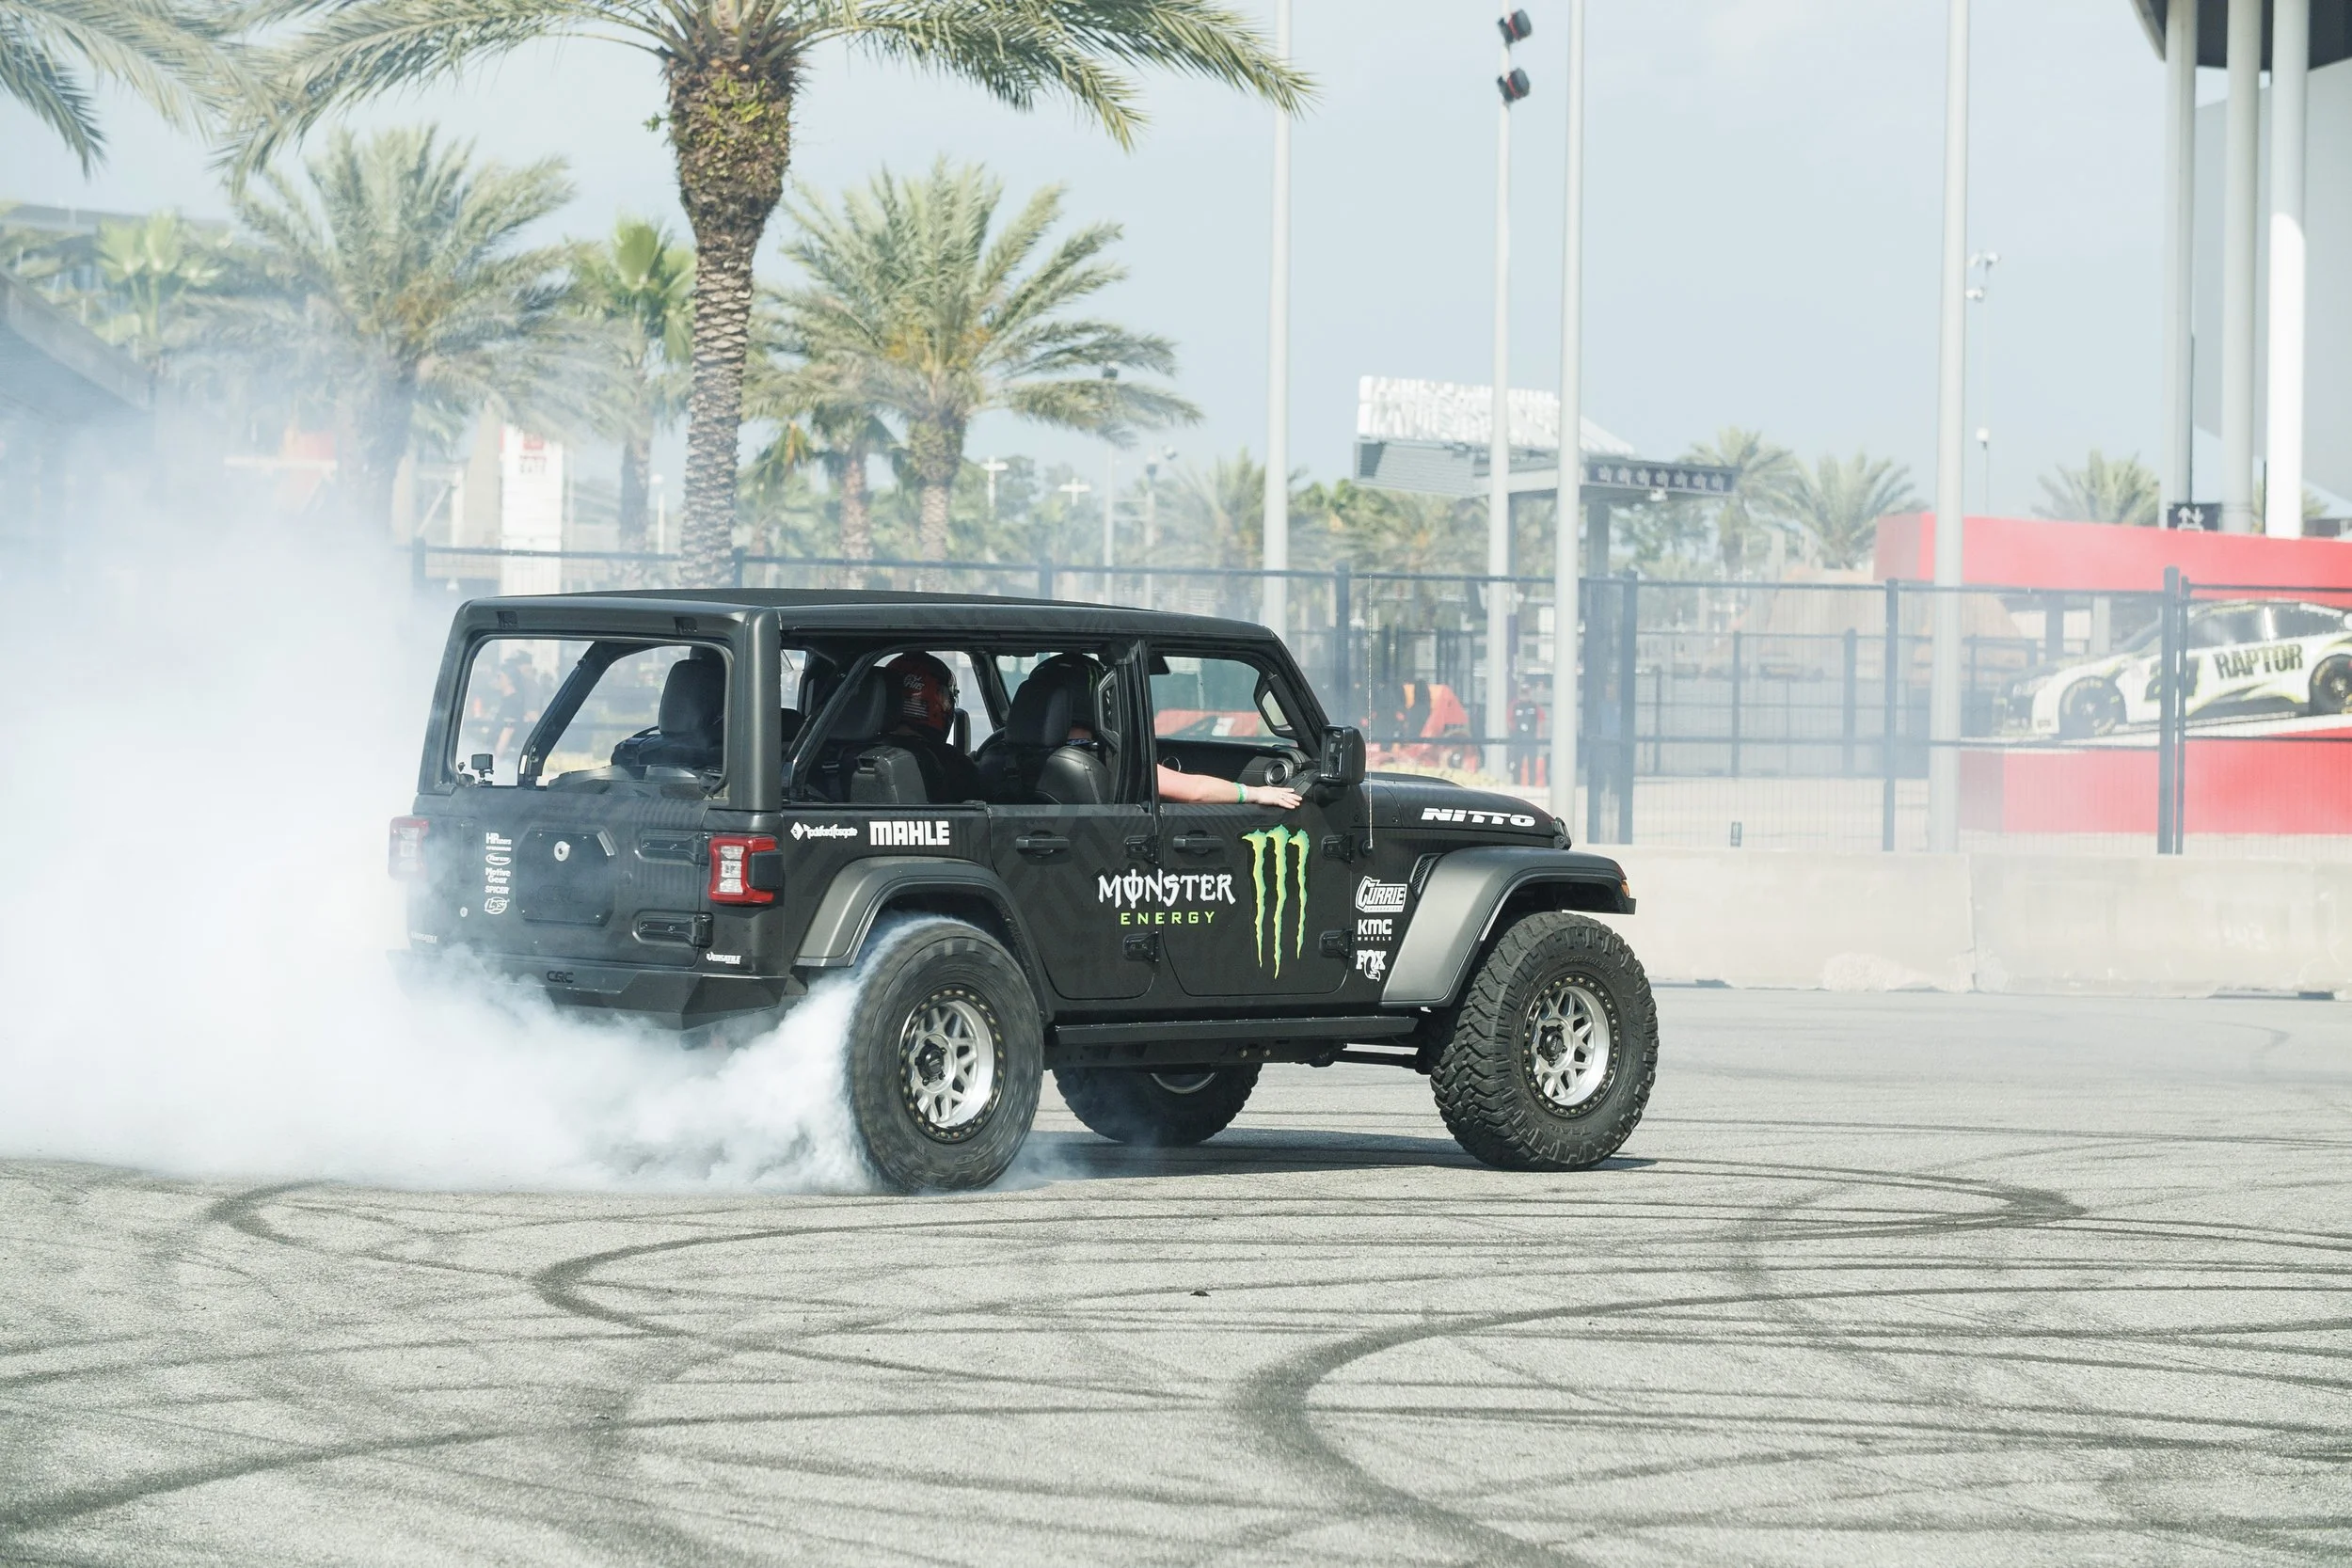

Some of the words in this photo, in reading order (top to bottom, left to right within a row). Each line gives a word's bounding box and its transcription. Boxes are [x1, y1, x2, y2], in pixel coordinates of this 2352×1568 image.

[2213, 644, 2303, 678] RAPTOR
[1421, 807, 1535, 827] NITTO
[869, 821, 949, 846] MAHLE
[485, 867, 511, 877] Motive
[485, 885, 510, 895] SPICER
[1097, 868, 1236, 909] MONSTER
[1358, 879, 1405, 908] CURRIE
[1120, 911, 1215, 925] ENERGY
[1358, 919, 1392, 935] KMC
[1356, 949, 1387, 981] FOX
